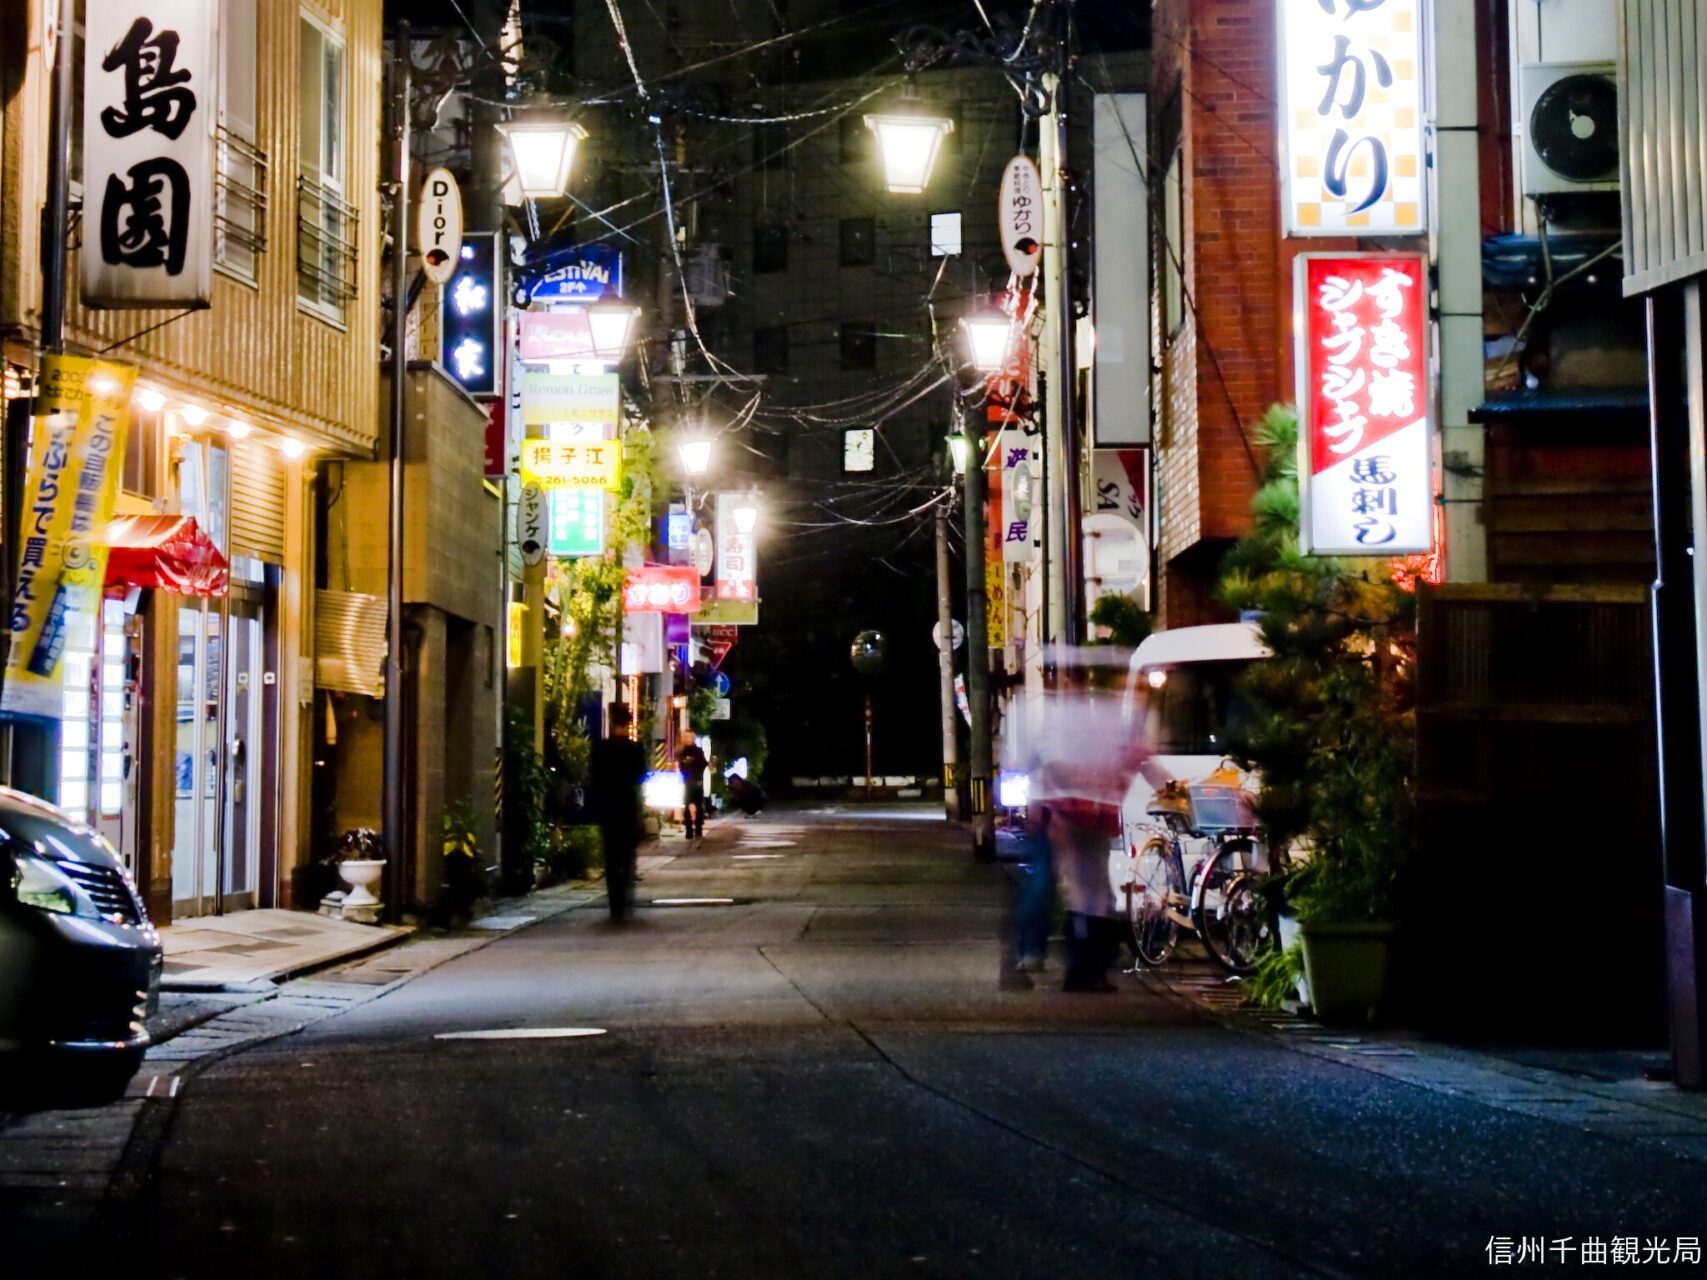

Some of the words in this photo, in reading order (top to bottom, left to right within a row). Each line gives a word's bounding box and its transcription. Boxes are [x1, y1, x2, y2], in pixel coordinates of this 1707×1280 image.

[431, 181, 448, 245] Dior
[1012, 195, 1032, 235] ゆかり
[528, 383, 574, 395] Remon
[579, 383, 614, 395] Grass
[533, 447, 604, 465] 揚子江
[1350, 455, 1397, 545] 馬刺し
